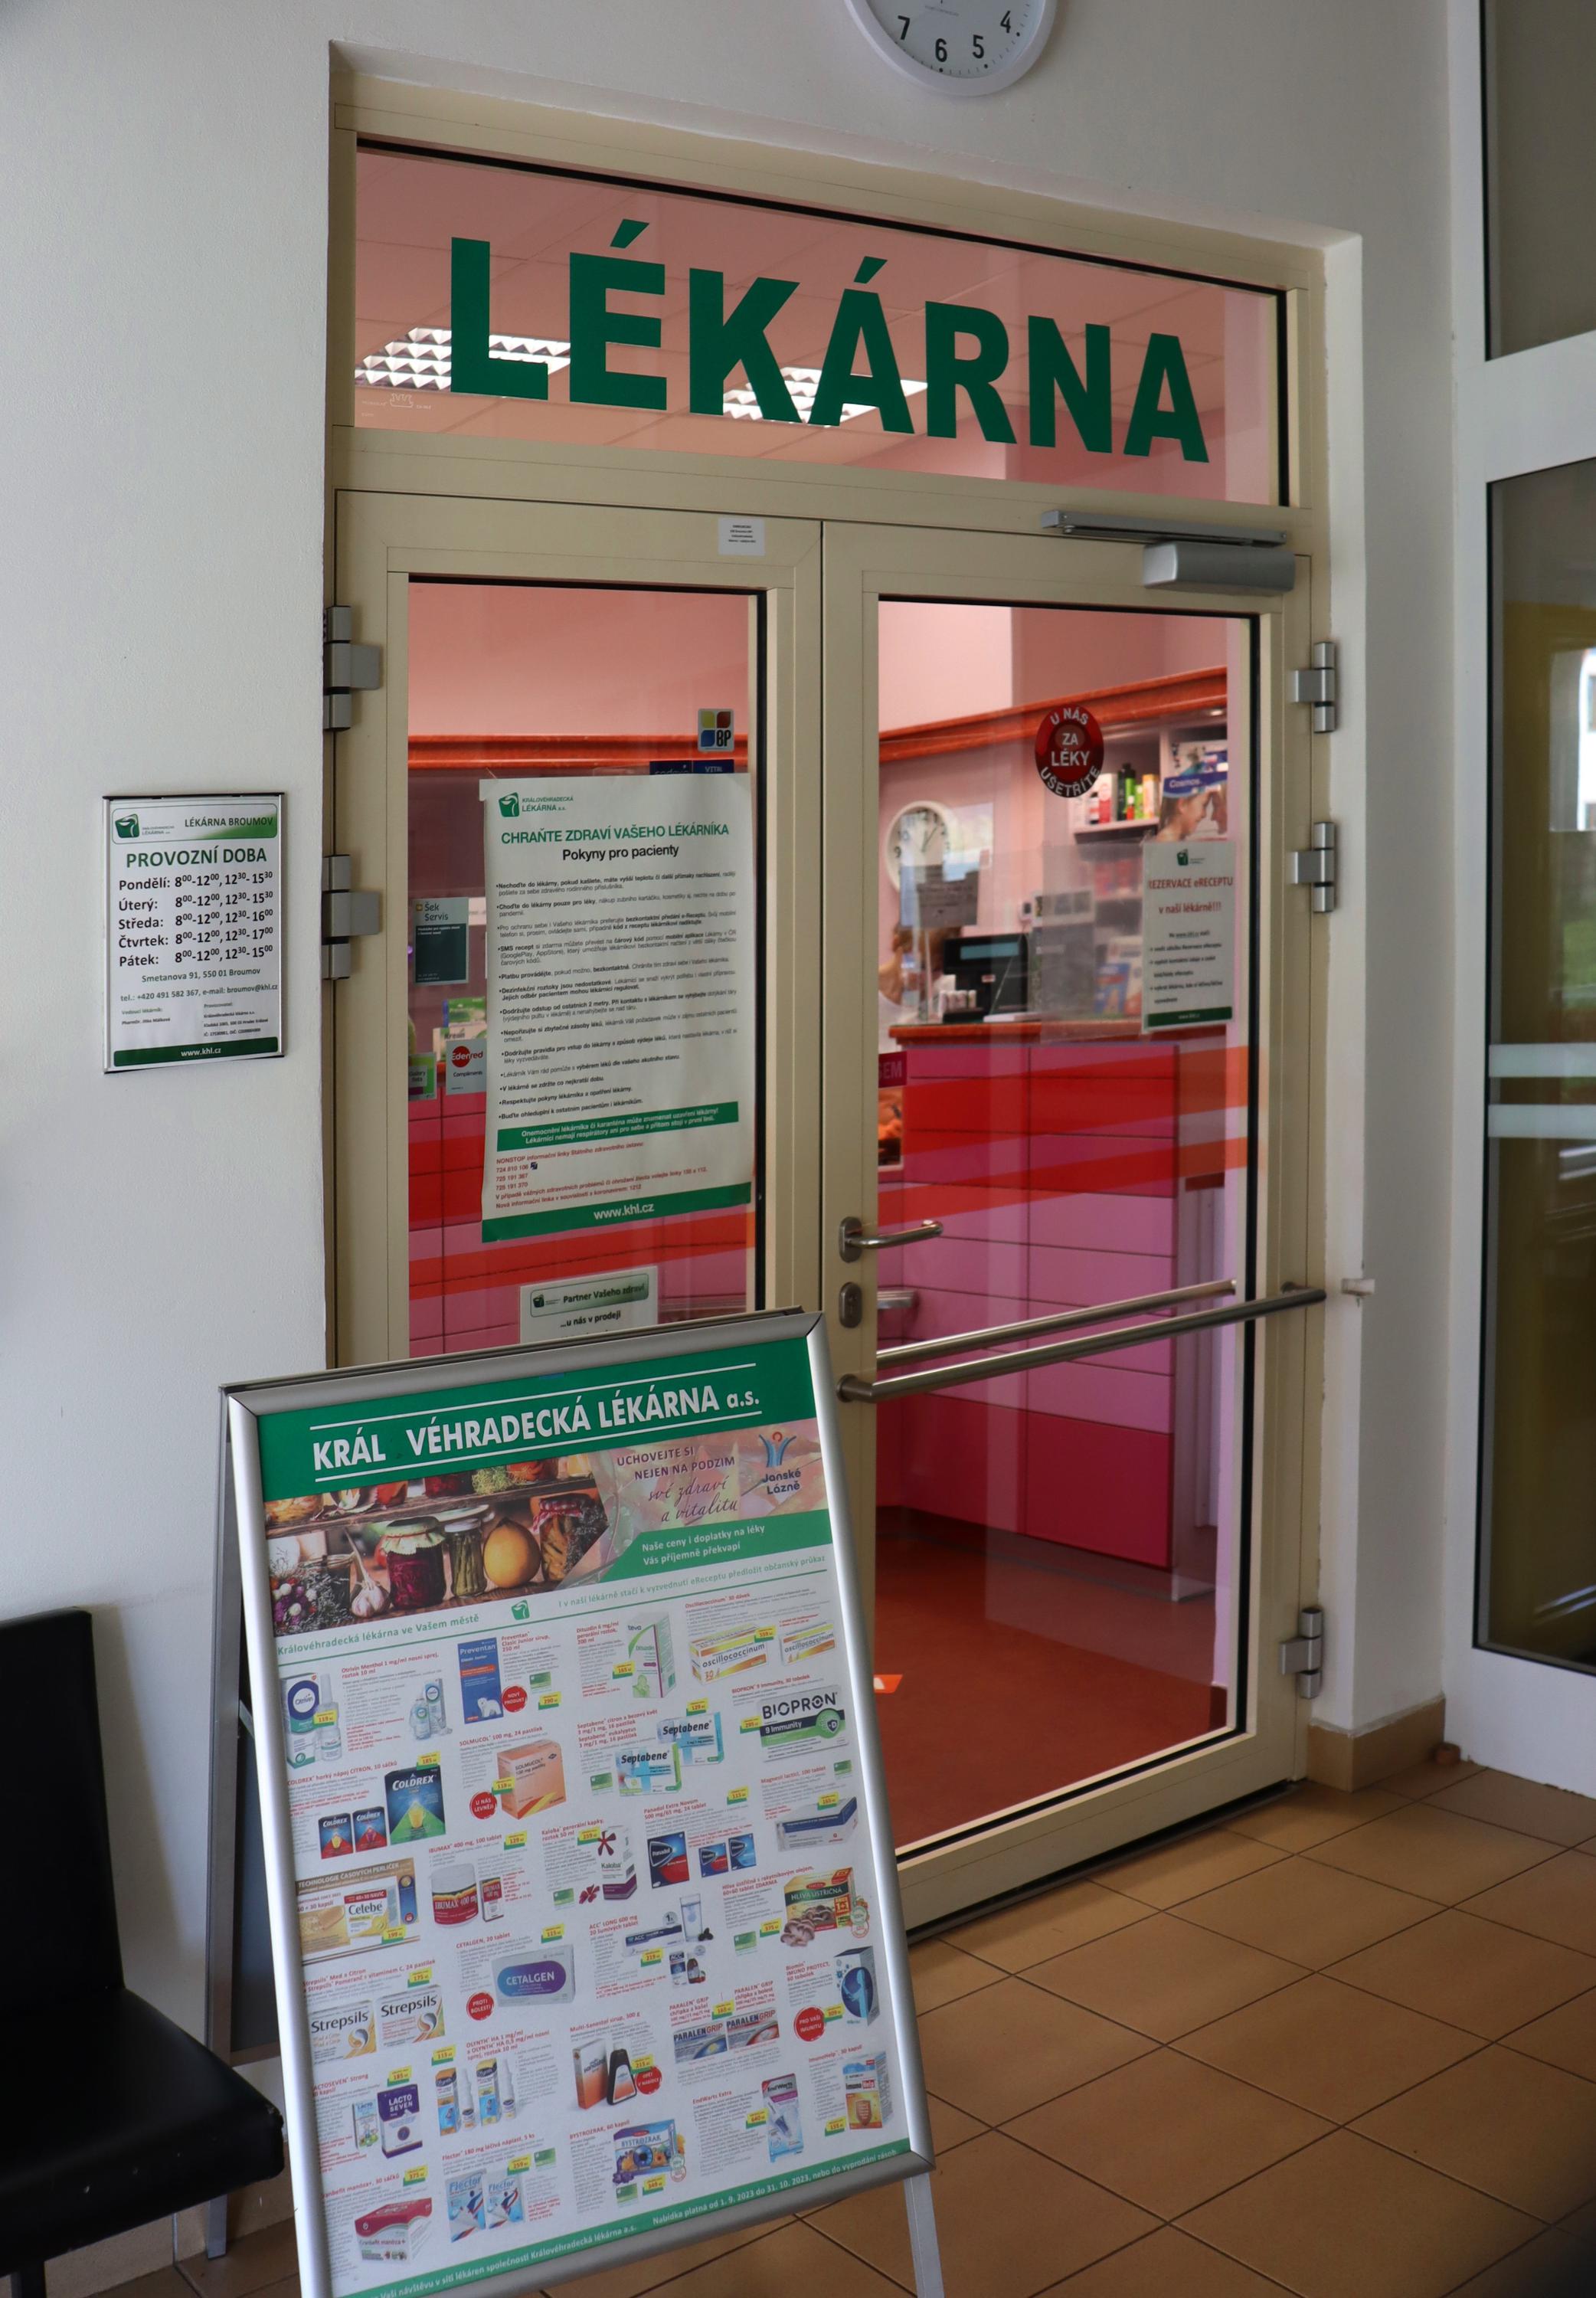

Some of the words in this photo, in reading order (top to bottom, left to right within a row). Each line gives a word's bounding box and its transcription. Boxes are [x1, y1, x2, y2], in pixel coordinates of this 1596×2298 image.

[898, 15, 911, 40] 7
[1000, 11, 1011, 33] 4
[935, 38, 947, 62] 6
[973, 34, 984, 59] 5
[450, 218, 1210, 463] LÉKÁRNA
[1050, 714, 1060, 726] U
[1063, 707, 1088, 725] NÁS
[1062, 732, 1078, 745] ZA
[1051, 748, 1091, 767] LÉKY
[1040, 766, 1101, 797] UŠETŘÍTE
[522, 804, 557, 812] LÉKÁRNA
[185, 817, 227, 828] LÉKÁRNA
[228, 816, 273, 827] BROUMOV
[501, 827, 562, 843] CHRAŇTE
[565, 825, 612, 841] ZDRAVÍ
[615, 824, 665, 840] VAŠEHO
[669, 822, 729, 837] LÉKÁRNÍKA
[126, 846, 218, 868] PROVOZNÍ
[223, 847, 267, 864] DOBA
[563, 848, 605, 862] Pokyny
[609, 849, 628, 860] pro
[632, 845, 679, 859] pacienty
[119, 878, 170, 891] Pondělí:
[119, 898, 158, 913] Úterý:
[424, 902, 440, 912] Šek
[119, 917, 163, 930] Středa:
[424, 912, 448, 921] Servis
[119, 935, 168, 948] Čtvrtek:
[119, 954, 159, 967] Pátek:
[142, 973, 187, 983] Smetanova
[229, 967, 260, 977] Broumov
[181, 1046, 221, 1058] www.khl.cz
[594, 1203, 655, 1220] www.khl.cz
[563, 1292, 591, 1303] Partner
[594, 1288, 620, 1298] Vašeho
[623, 1284, 645, 1295] zdraví
[574, 1316, 587, 1325] nás
[594, 1311, 621, 1324] prodeji
[312, 1427, 386, 1471] KRÁL
[406, 1396, 591, 1456] VÉHRADECKÁ
[598, 1385, 720, 1429] LÉKÁRNA
[726, 1390, 760, 1408] a.s.
[617, 1449, 682, 1467] UCHOVEJTE
[685, 1447, 695, 1456] SI
[635, 1467, 669, 1480] NEJEN
[672, 1464, 688, 1475] NA
[692, 1456, 735, 1471] PODZIM
[763, 1468, 801, 1483] Janské
[767, 1481, 800, 1494] Lázně
[643, 1540, 663, 1553] Naše
[666, 1538, 686, 1550] ceny
[694, 1530, 731, 1544] doplatky
[734, 1528, 744, 1537] na
[747, 1525, 765, 1537] léky
[643, 1555, 659, 1566] Vás
[661, 1547, 701, 1564] příjemně
[703, 1543, 741, 1559] překvapí
[277, 1632, 360, 1655] Královéhradecká
[362, 1626, 399, 1642] lékárna
[401, 1627, 413, 1635] ve
[415, 1618, 447, 1633] Vašem
[450, 1614, 479, 1628] městě
[702, 1643, 765, 1669] oscillococcinum
[762, 1692, 836, 1719] BIOPRON
[663, 1722, 710, 1735] Septabene
[621, 1752, 667, 1764] Septabene
[391, 1773, 434, 1790] COLDREX
[505, 1970, 554, 1986] CETALGEN
[381, 1994, 437, 2018] Strepsils
[311, 2011, 368, 2034] Strepsils
[652, 2211, 683, 2225] Nabídka
[685, 2203, 708, 2218] platná
[709, 2200, 718, 2208] od
[756, 2187, 765, 2195] do
[531, 2234, 593, 2259] Královéhradecká
[594, 2228, 622, 2242] lékárna
